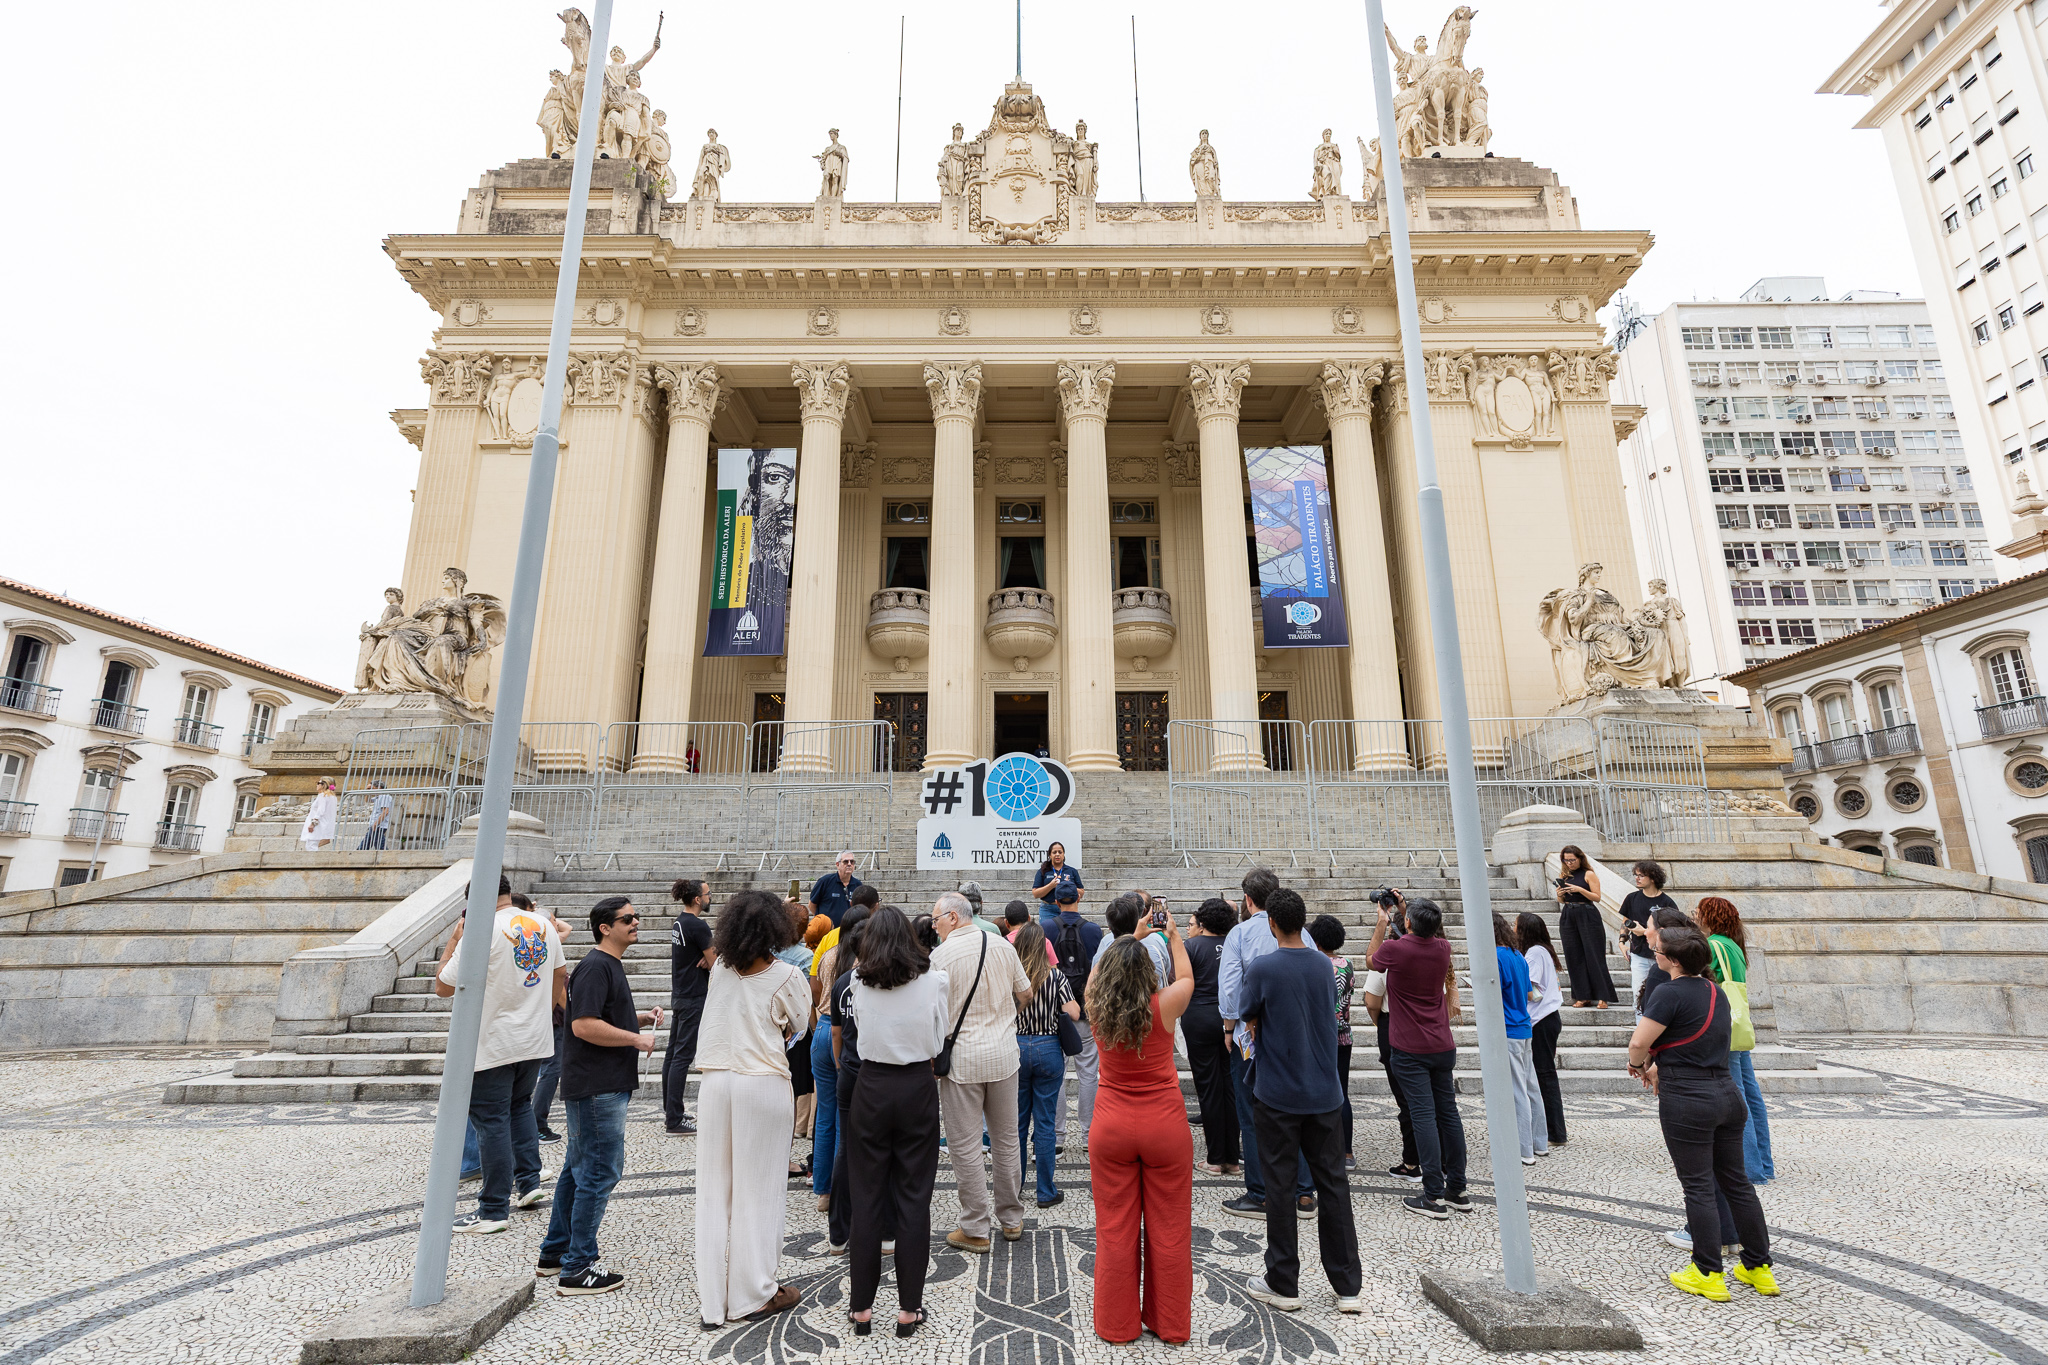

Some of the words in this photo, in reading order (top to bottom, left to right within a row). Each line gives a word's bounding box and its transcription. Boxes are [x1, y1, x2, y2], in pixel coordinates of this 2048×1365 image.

[1001, 157, 1035, 171] LEX
[724, 505, 732, 527] ALERJ
[1302, 485, 1318, 544] TIRADENTES
[723, 528, 730, 540] DA
[739, 522, 747, 551] Legislativo
[1322, 518, 1332, 545] visitação
[720, 540, 729, 580] HISTÓRICA
[1327, 545, 1335, 561] para
[1310, 545, 1324, 589] PALÁCIO
[1329, 561, 1337, 585] Aberto
[718, 581, 726, 600] SEDE
[732, 631, 761, 641] ALERJ
[996, 837, 1040, 849] PALÁCIO
[930, 851, 954, 860] ALERJ
[971, 850, 1050, 864] TIRADENT
[582, 1275, 598, 1287] N
